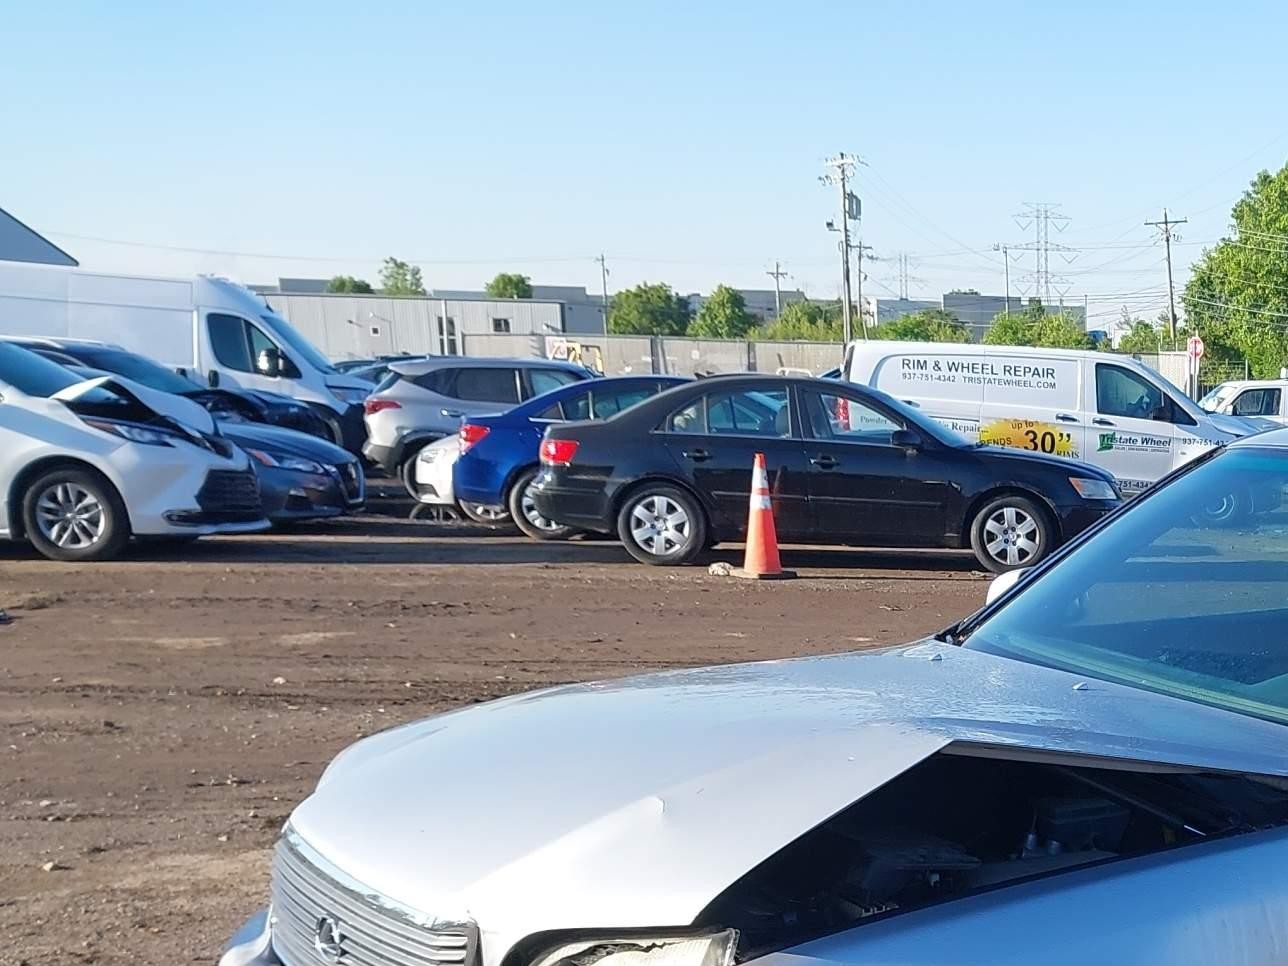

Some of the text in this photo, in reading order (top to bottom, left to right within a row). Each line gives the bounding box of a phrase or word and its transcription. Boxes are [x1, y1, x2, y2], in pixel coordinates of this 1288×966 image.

[902, 358, 1056, 379] RIM & WHEEL REPAIR
[902, 372, 1057, 389] 937-751-4342 TRISTATEWHEEL.COM
[1011, 421, 1034, 431] up to
[1140, 436, 1172, 448] Wheel
